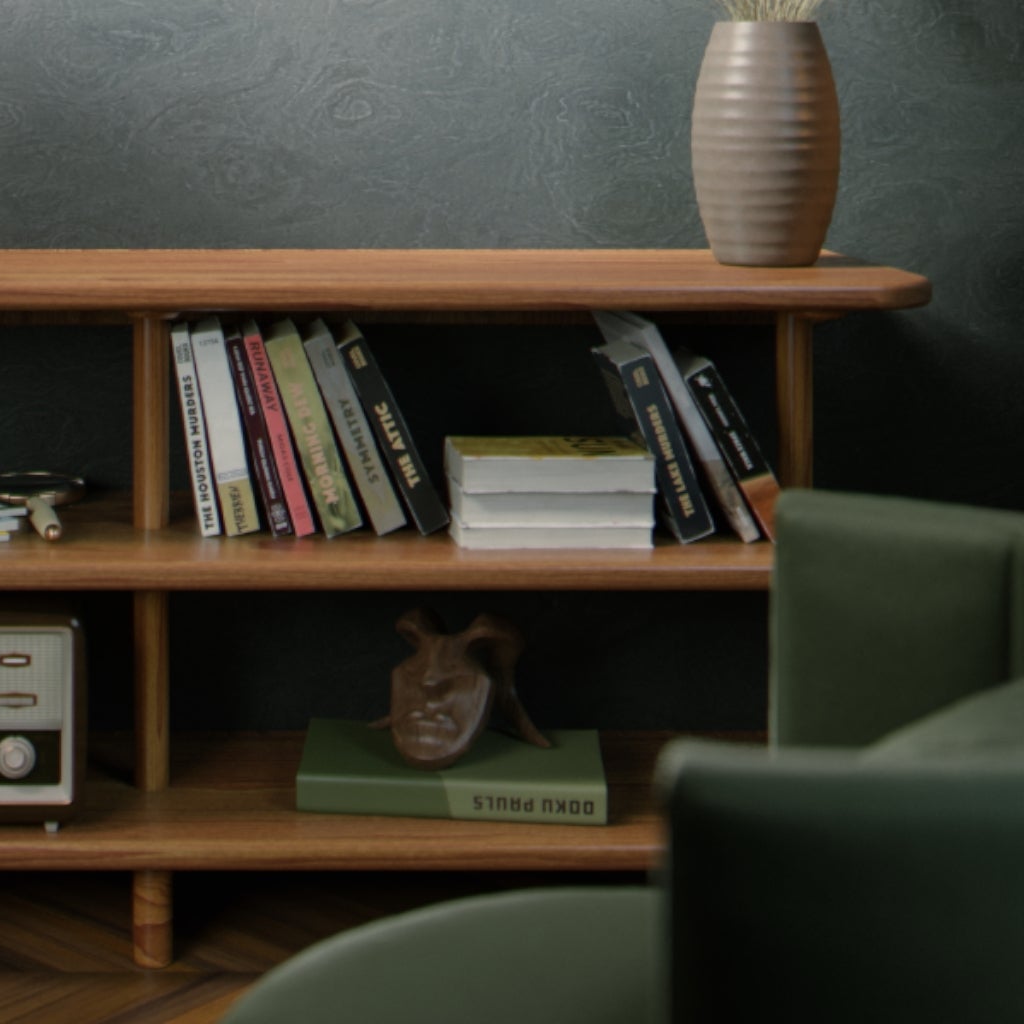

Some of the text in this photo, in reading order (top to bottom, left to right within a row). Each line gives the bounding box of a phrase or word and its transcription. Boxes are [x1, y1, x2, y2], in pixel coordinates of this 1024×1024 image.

[250, 341, 278, 411] RUNAWAY
[182, 375, 214, 530] THE HOUSTON MURDERS
[303, 422, 338, 504] MORNING
[339, 399, 379, 484] SYMMETRY
[375, 402, 420, 488] THE ATTIC
[679, 492, 695, 518] THE
[473, 795, 594, 815] DOKU PAULS
